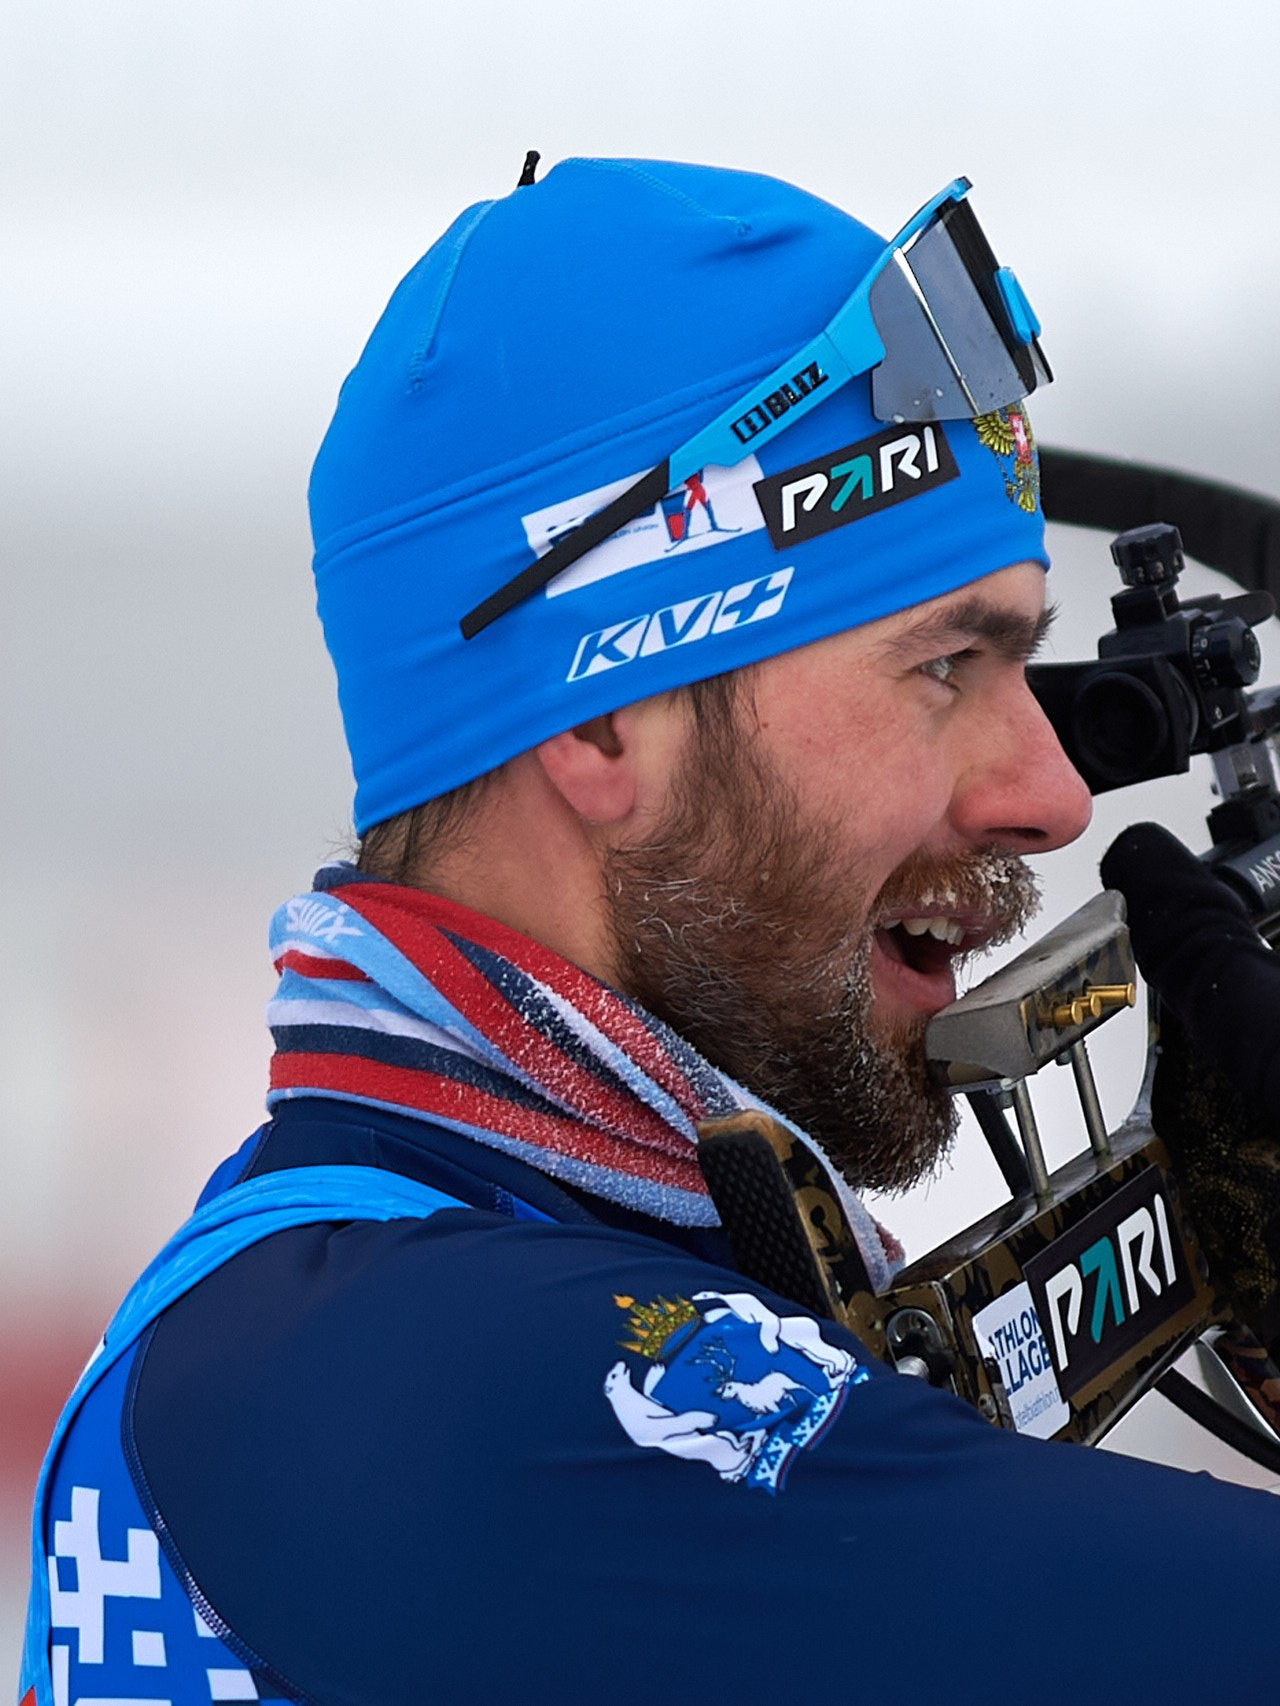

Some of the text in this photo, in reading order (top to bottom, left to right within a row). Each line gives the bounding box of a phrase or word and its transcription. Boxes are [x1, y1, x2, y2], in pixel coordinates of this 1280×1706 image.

[780, 424, 940, 533] PARI
[1045, 1192, 1177, 1373] PARI
[1005, 1334, 1052, 1397] LAGE
